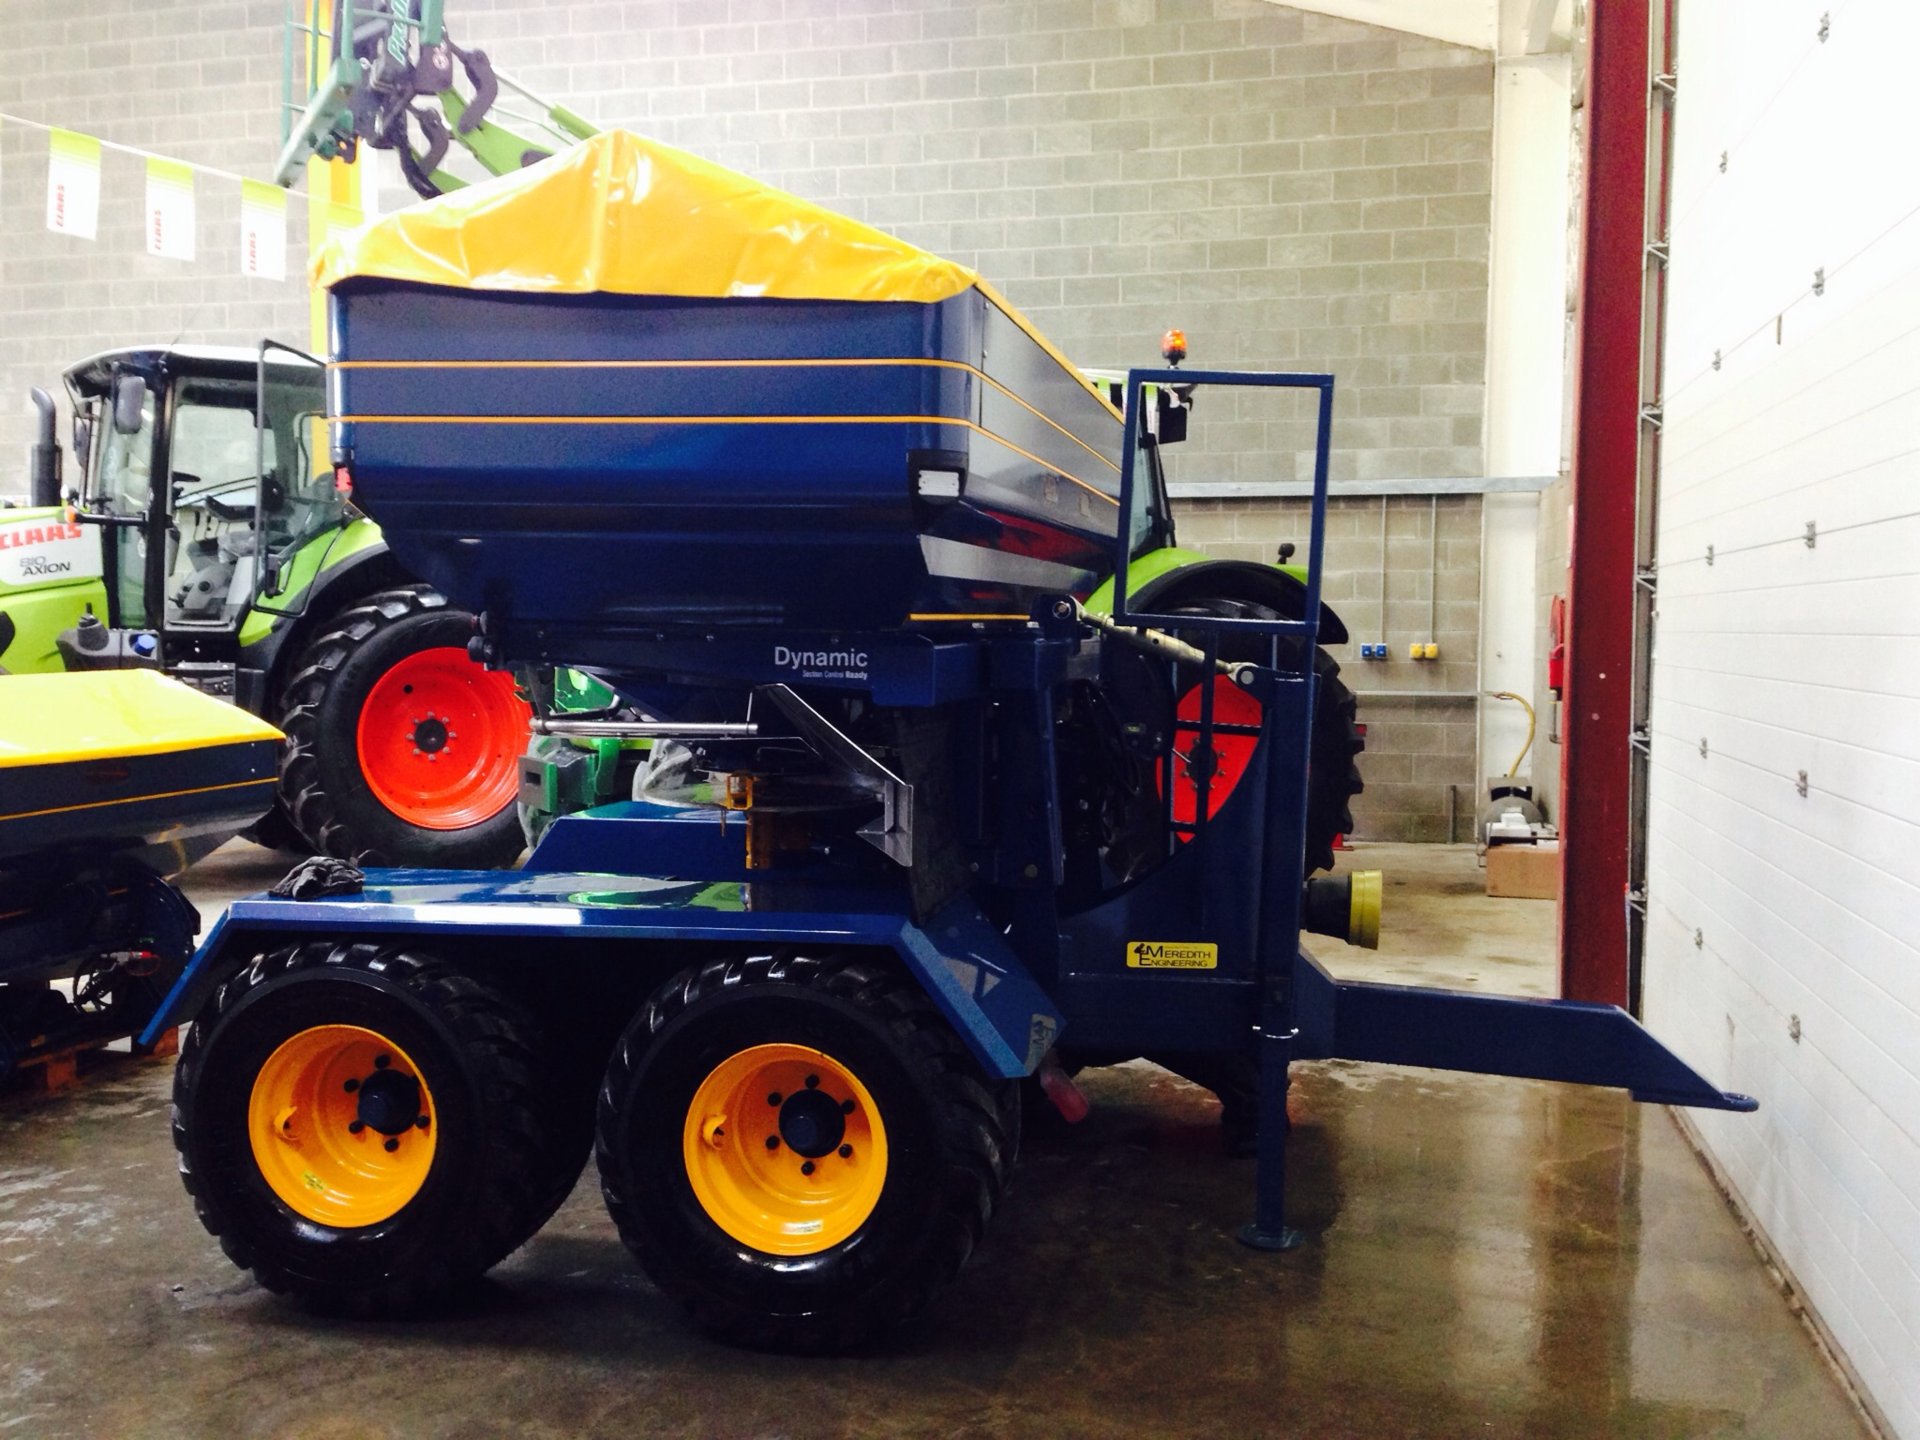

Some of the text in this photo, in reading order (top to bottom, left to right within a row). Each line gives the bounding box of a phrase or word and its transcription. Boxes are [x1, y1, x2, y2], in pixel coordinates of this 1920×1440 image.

[56, 185, 65, 227] CLAAS
[0, 523, 82, 550] CLAAS
[23, 562, 71, 576] AXION
[774, 646, 868, 669] Dynamic
[802, 670, 868, 680] Section Control Ready
[1139, 951, 1208, 967] ENGINEERING
[1146, 945, 1211, 958] MEREDITH
